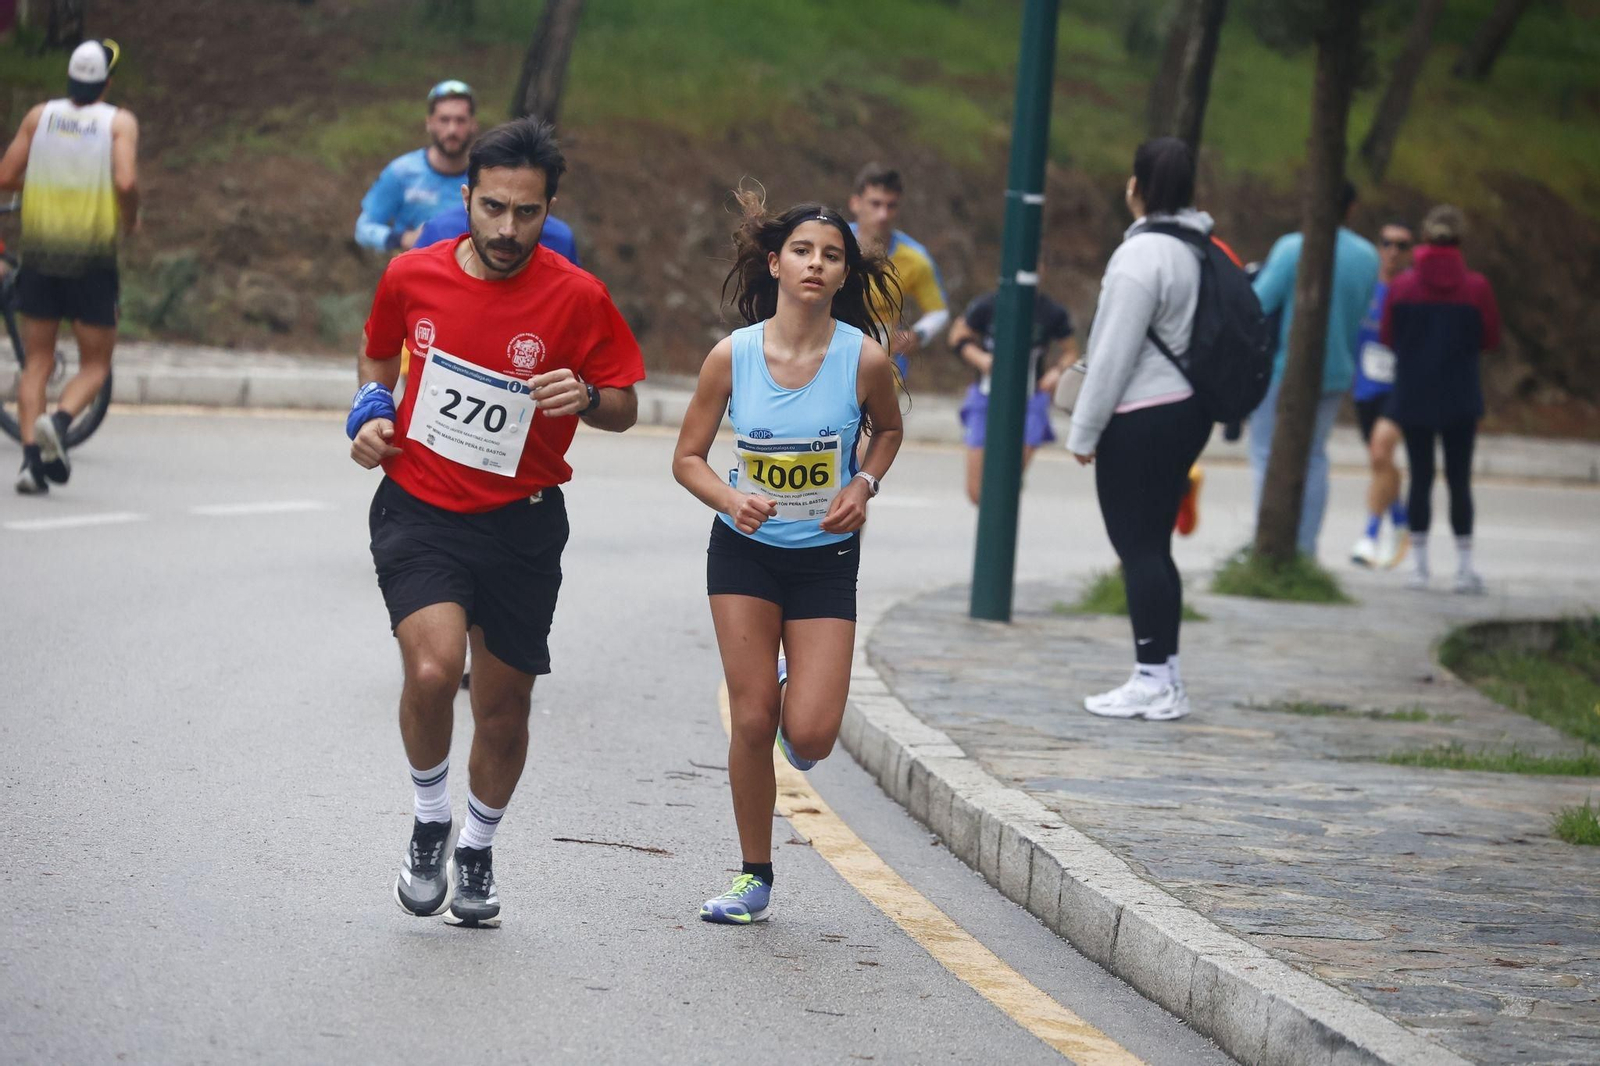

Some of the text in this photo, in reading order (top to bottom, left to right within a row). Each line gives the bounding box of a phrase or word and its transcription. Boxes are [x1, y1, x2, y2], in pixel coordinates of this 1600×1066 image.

[439, 388, 507, 433] 270
[441, 433, 465, 445] MARATÓN
[465, 441, 478, 450] PEÑA
[486, 448, 507, 457] BASTÓN
[750, 430, 772, 439] TROPS
[752, 459, 829, 489] 1006
